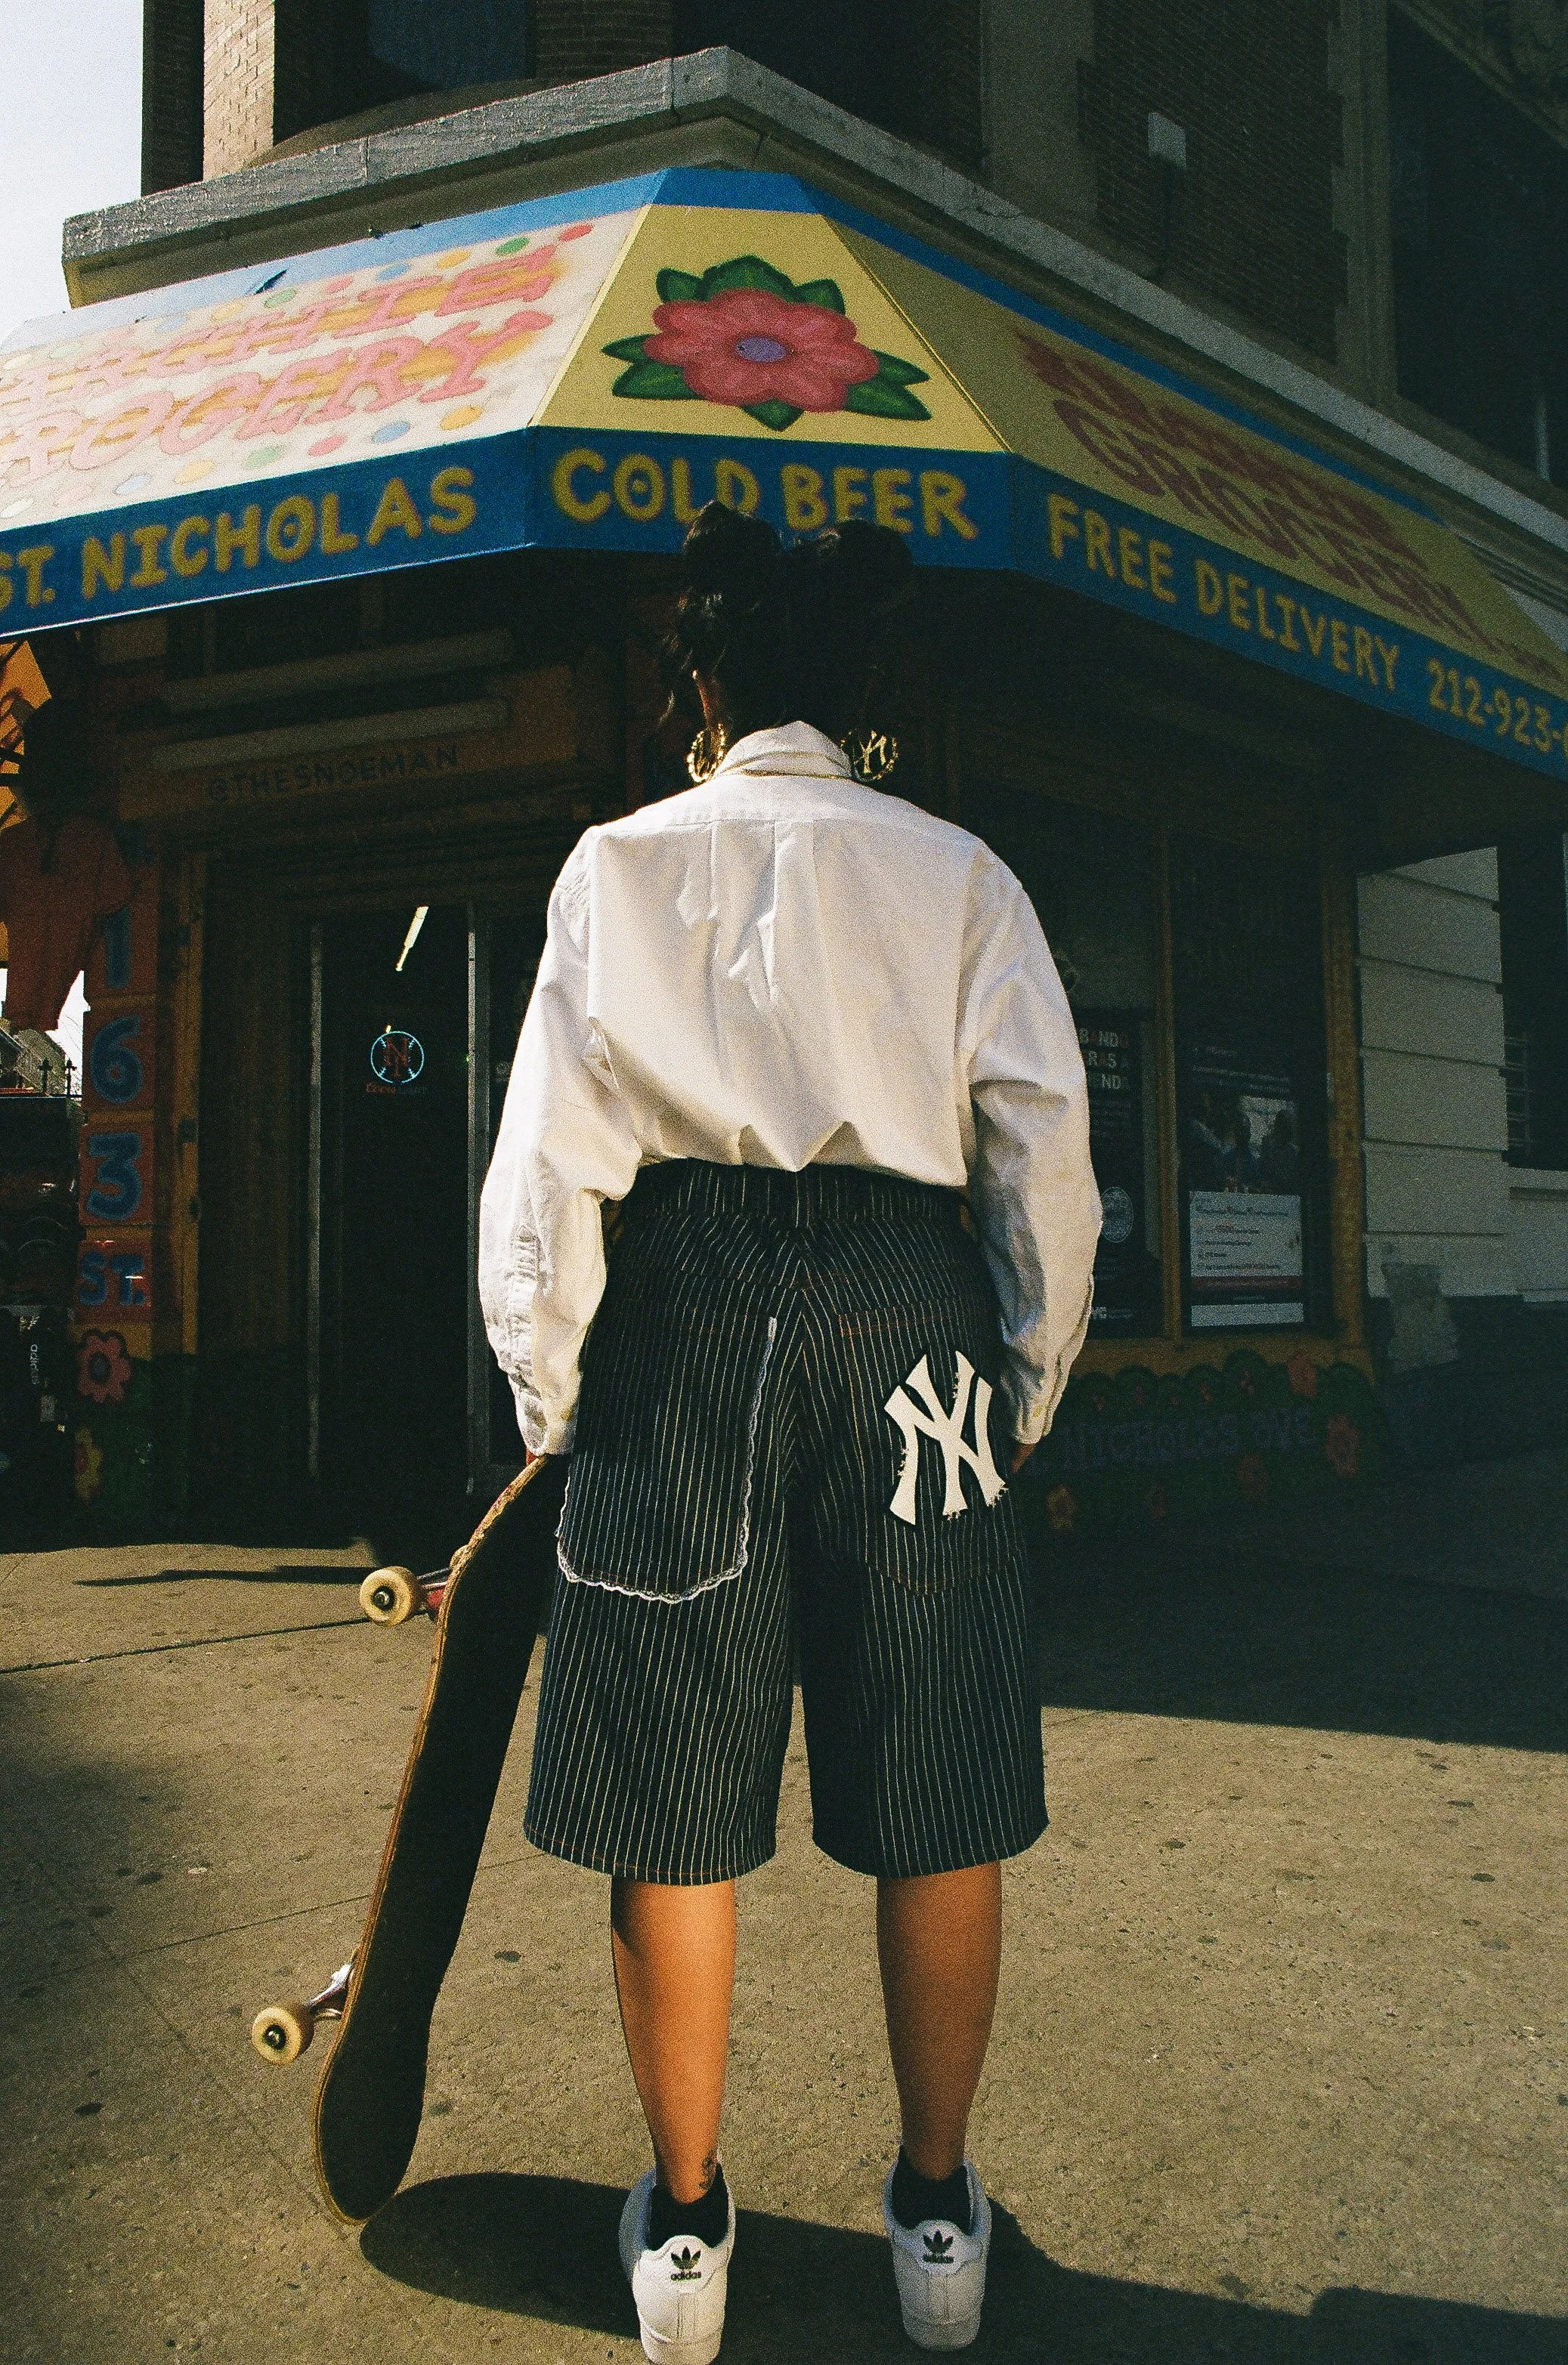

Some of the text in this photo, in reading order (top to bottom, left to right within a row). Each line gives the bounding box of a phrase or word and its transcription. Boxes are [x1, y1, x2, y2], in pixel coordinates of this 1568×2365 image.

[0, 311, 553, 490] ROCERY
[82, 466, 478, 600] NICHOLAS
[550, 447, 980, 540] COLD BEER
[1053, 398, 1498, 653] GROCERY
[1047, 492, 1178, 604] FREE
[1194, 557, 1400, 691] DELIVERY
[79, 1249, 146, 1306] ST.
[883, 1349, 1010, 1526] NY
[670, 2269, 703, 2281] adidas
